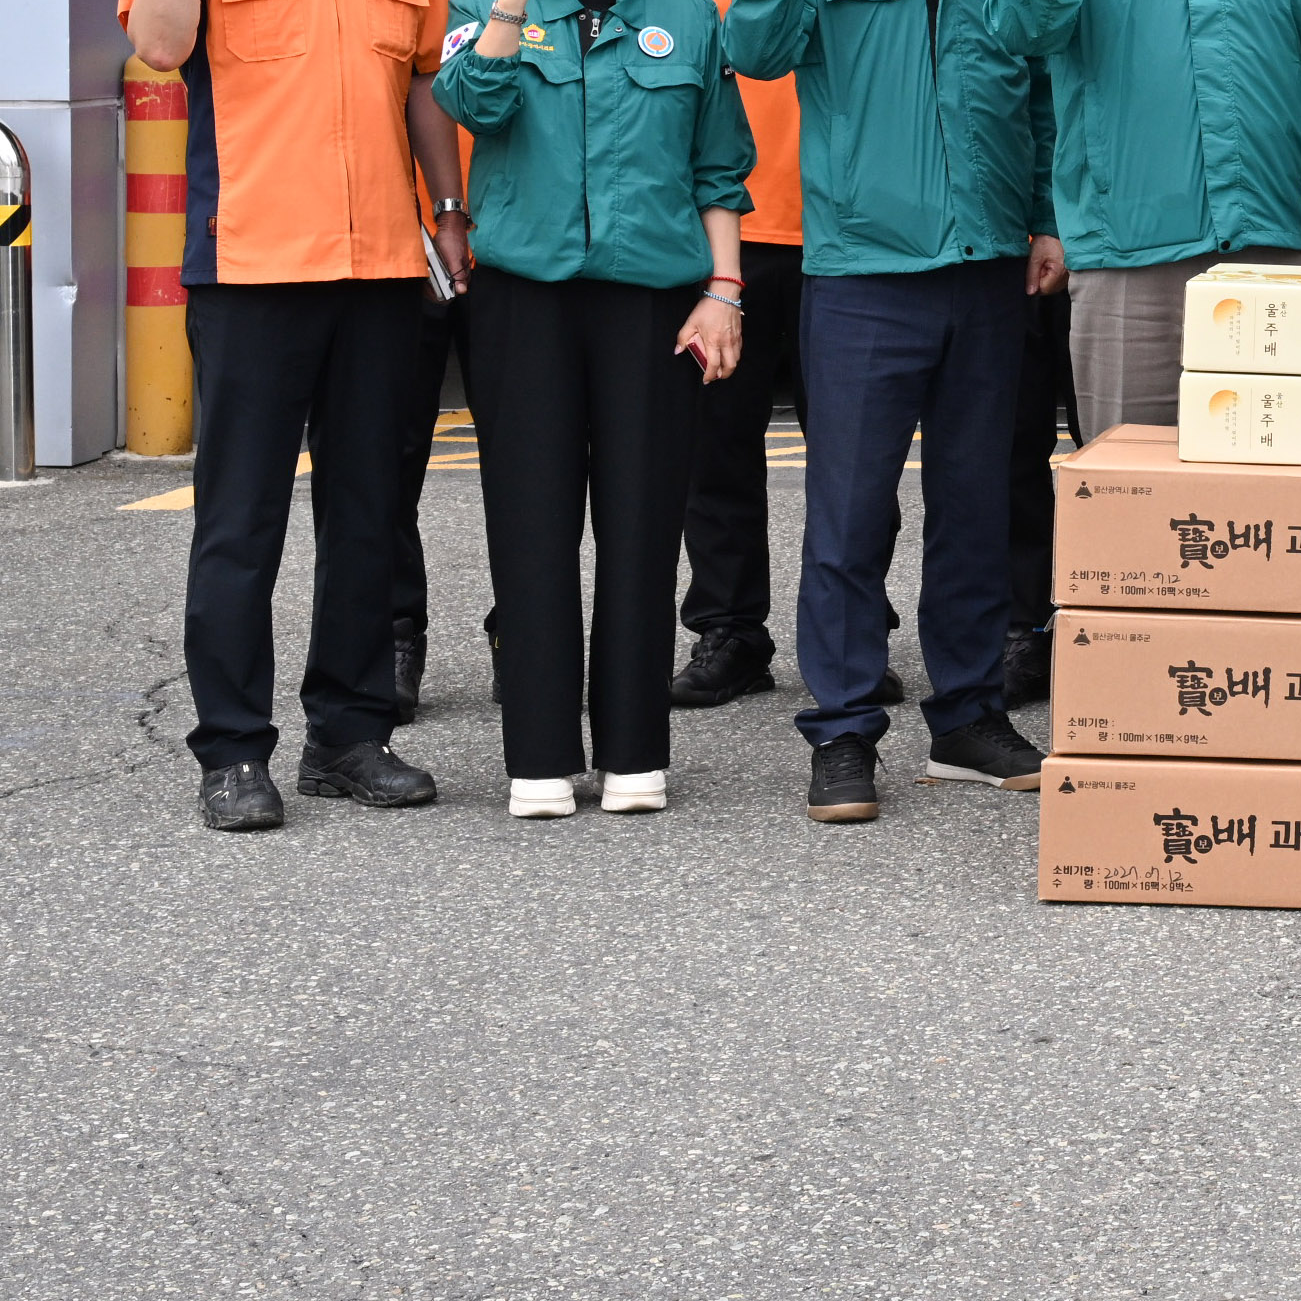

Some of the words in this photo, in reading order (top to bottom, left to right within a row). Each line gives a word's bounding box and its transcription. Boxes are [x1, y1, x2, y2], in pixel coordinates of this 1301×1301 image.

[1264, 303, 1279, 356] 울주배
[1260, 394, 1275, 447] 울주배
[1094, 486, 1129, 495] 울산광역시
[1092, 632, 1128, 641] 울산광역시
[1077, 780, 1113, 790] 울산광역시
